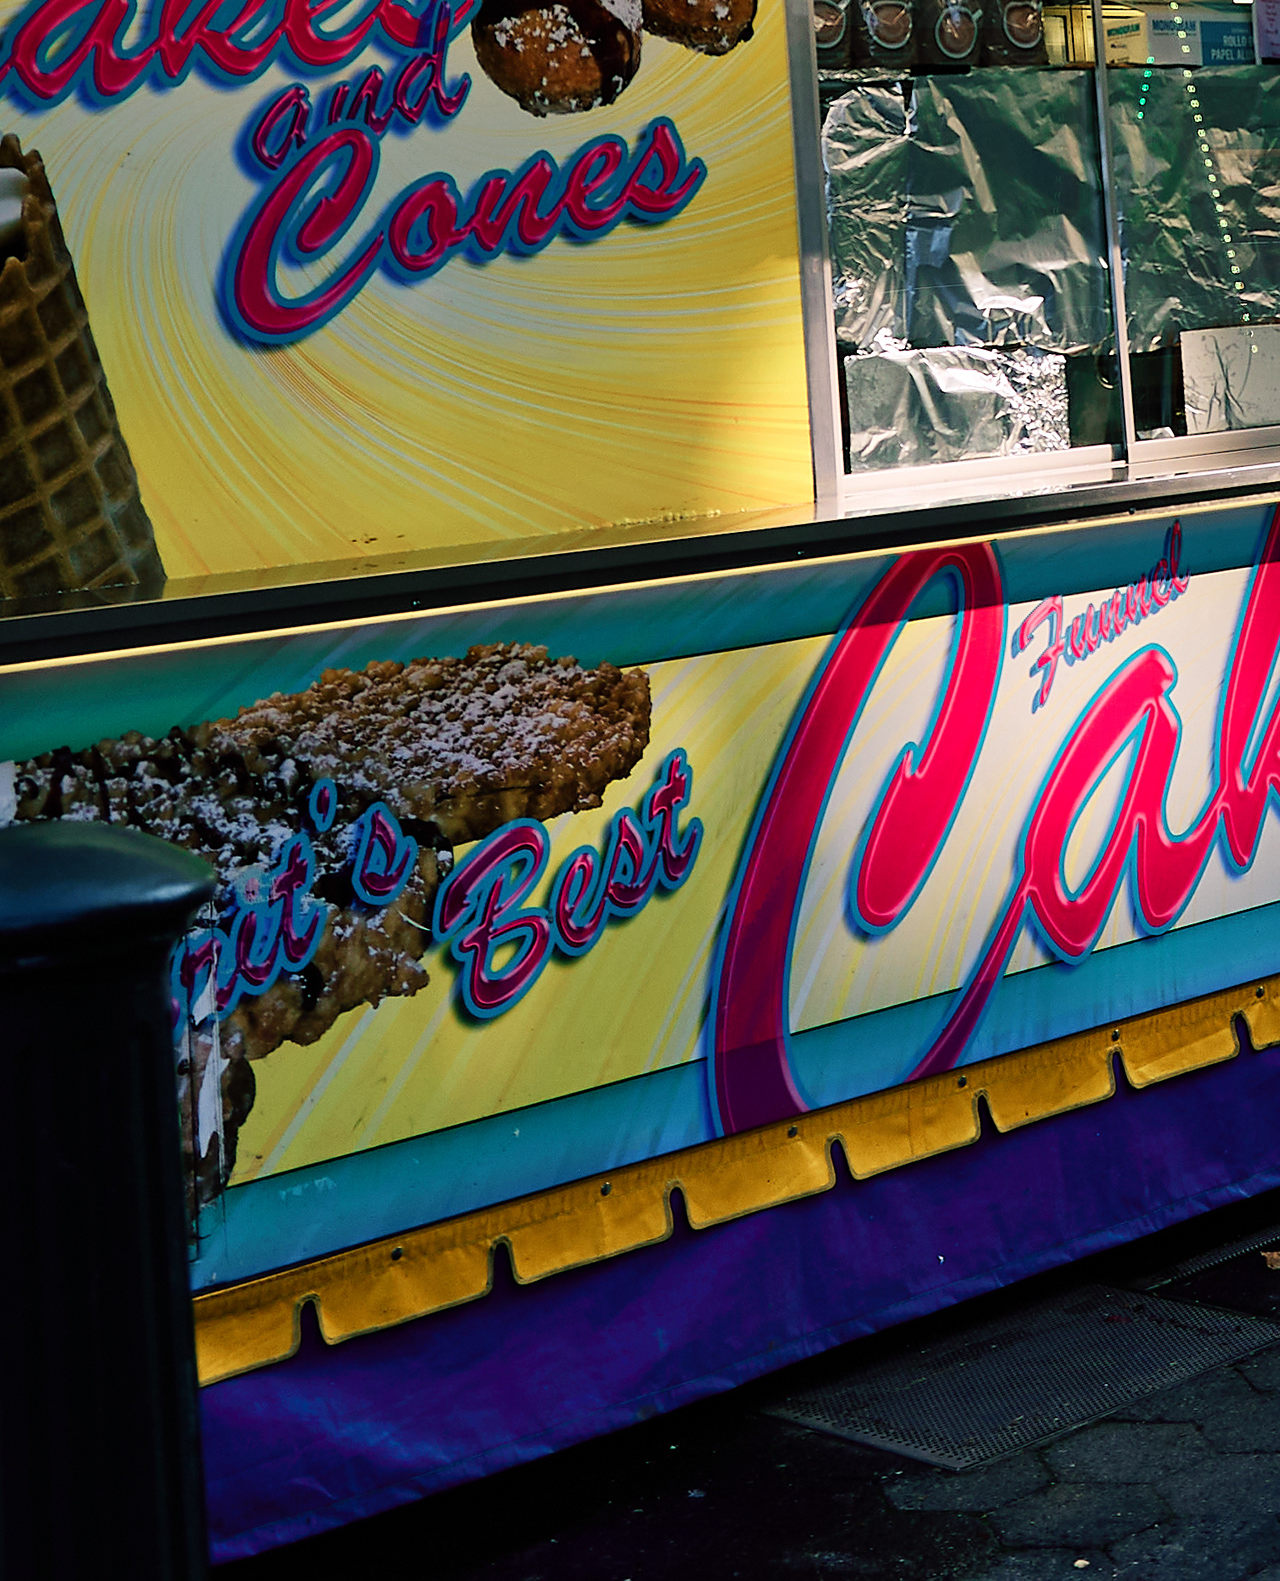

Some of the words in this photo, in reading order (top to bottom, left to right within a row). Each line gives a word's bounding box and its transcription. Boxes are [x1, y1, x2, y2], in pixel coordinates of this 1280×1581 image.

[248, 0, 472, 174] and
[218, 116, 709, 348] Cones
[1012, 519, 1191, 714] Funnel
[172, 777, 418, 1024] rit's
[432, 746, 706, 1022] Best
